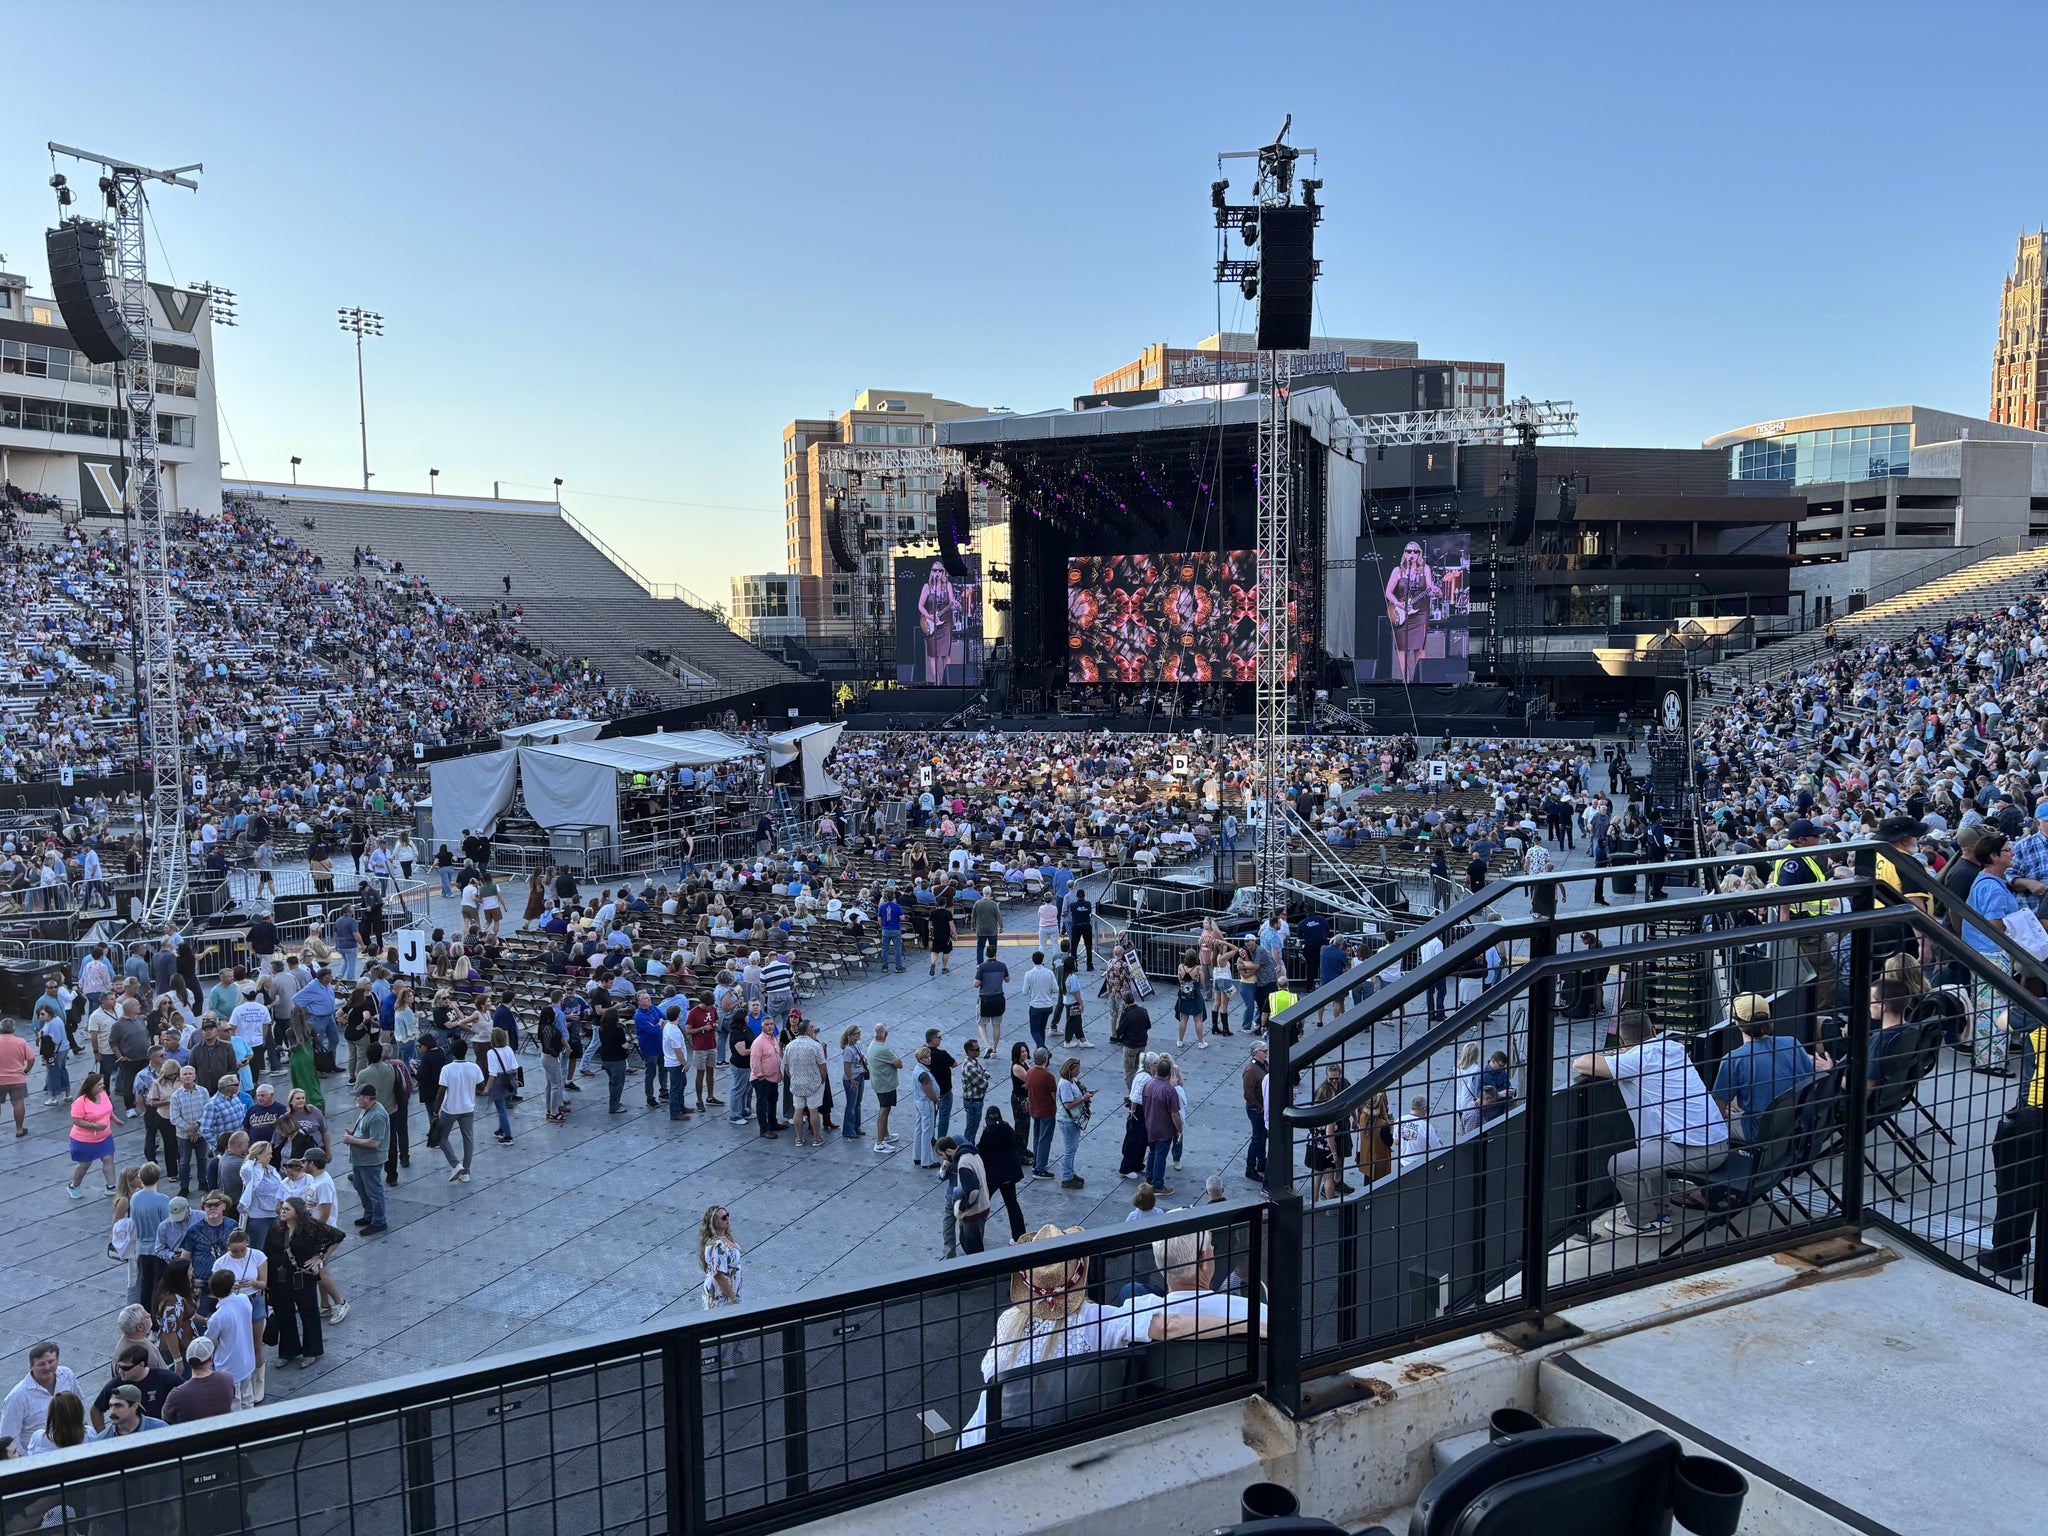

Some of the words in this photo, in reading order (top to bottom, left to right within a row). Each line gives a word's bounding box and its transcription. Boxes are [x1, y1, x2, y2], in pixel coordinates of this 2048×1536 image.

[151, 285, 207, 333] V
[415, 746, 421, 755] A
[1176, 760, 1184, 769] D
[1433, 765, 1443, 775] E
[63, 772, 69, 781] F
[923, 770, 930, 781] H
[194, 780, 203, 789] G
[404, 940, 417, 962] J
[249, 1111, 278, 1126] Eagles
